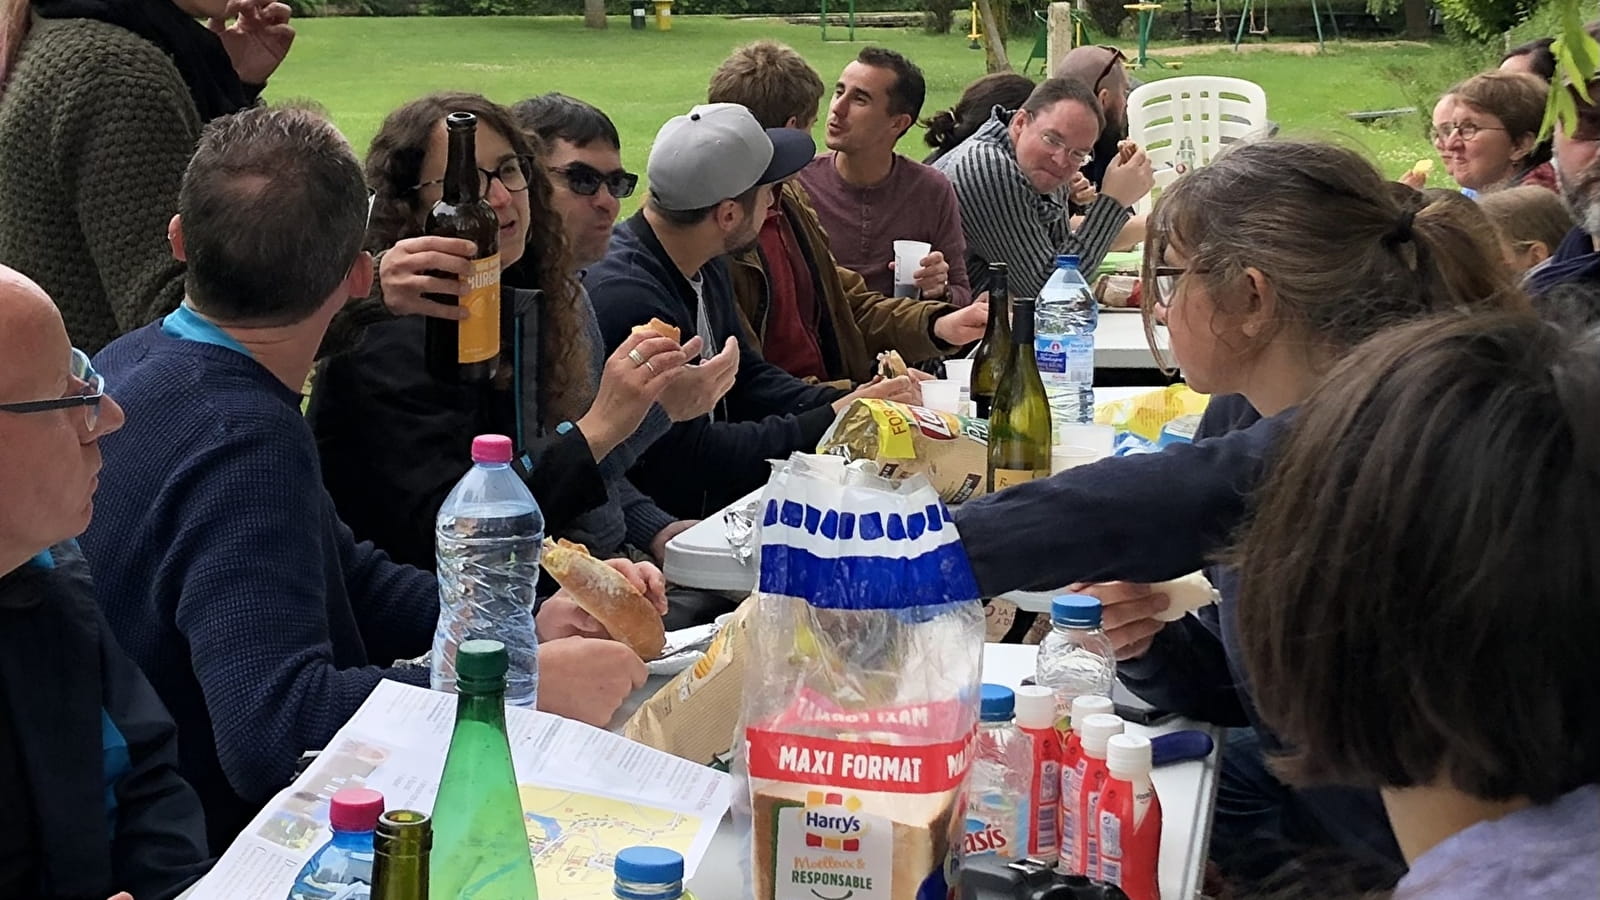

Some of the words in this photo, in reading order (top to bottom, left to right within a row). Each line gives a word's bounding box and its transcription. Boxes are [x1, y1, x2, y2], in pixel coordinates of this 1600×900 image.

[778, 745, 835, 776] MAXI
[841, 753, 922, 783] FORMAT
[791, 870, 873, 890] RESPONSABLE
